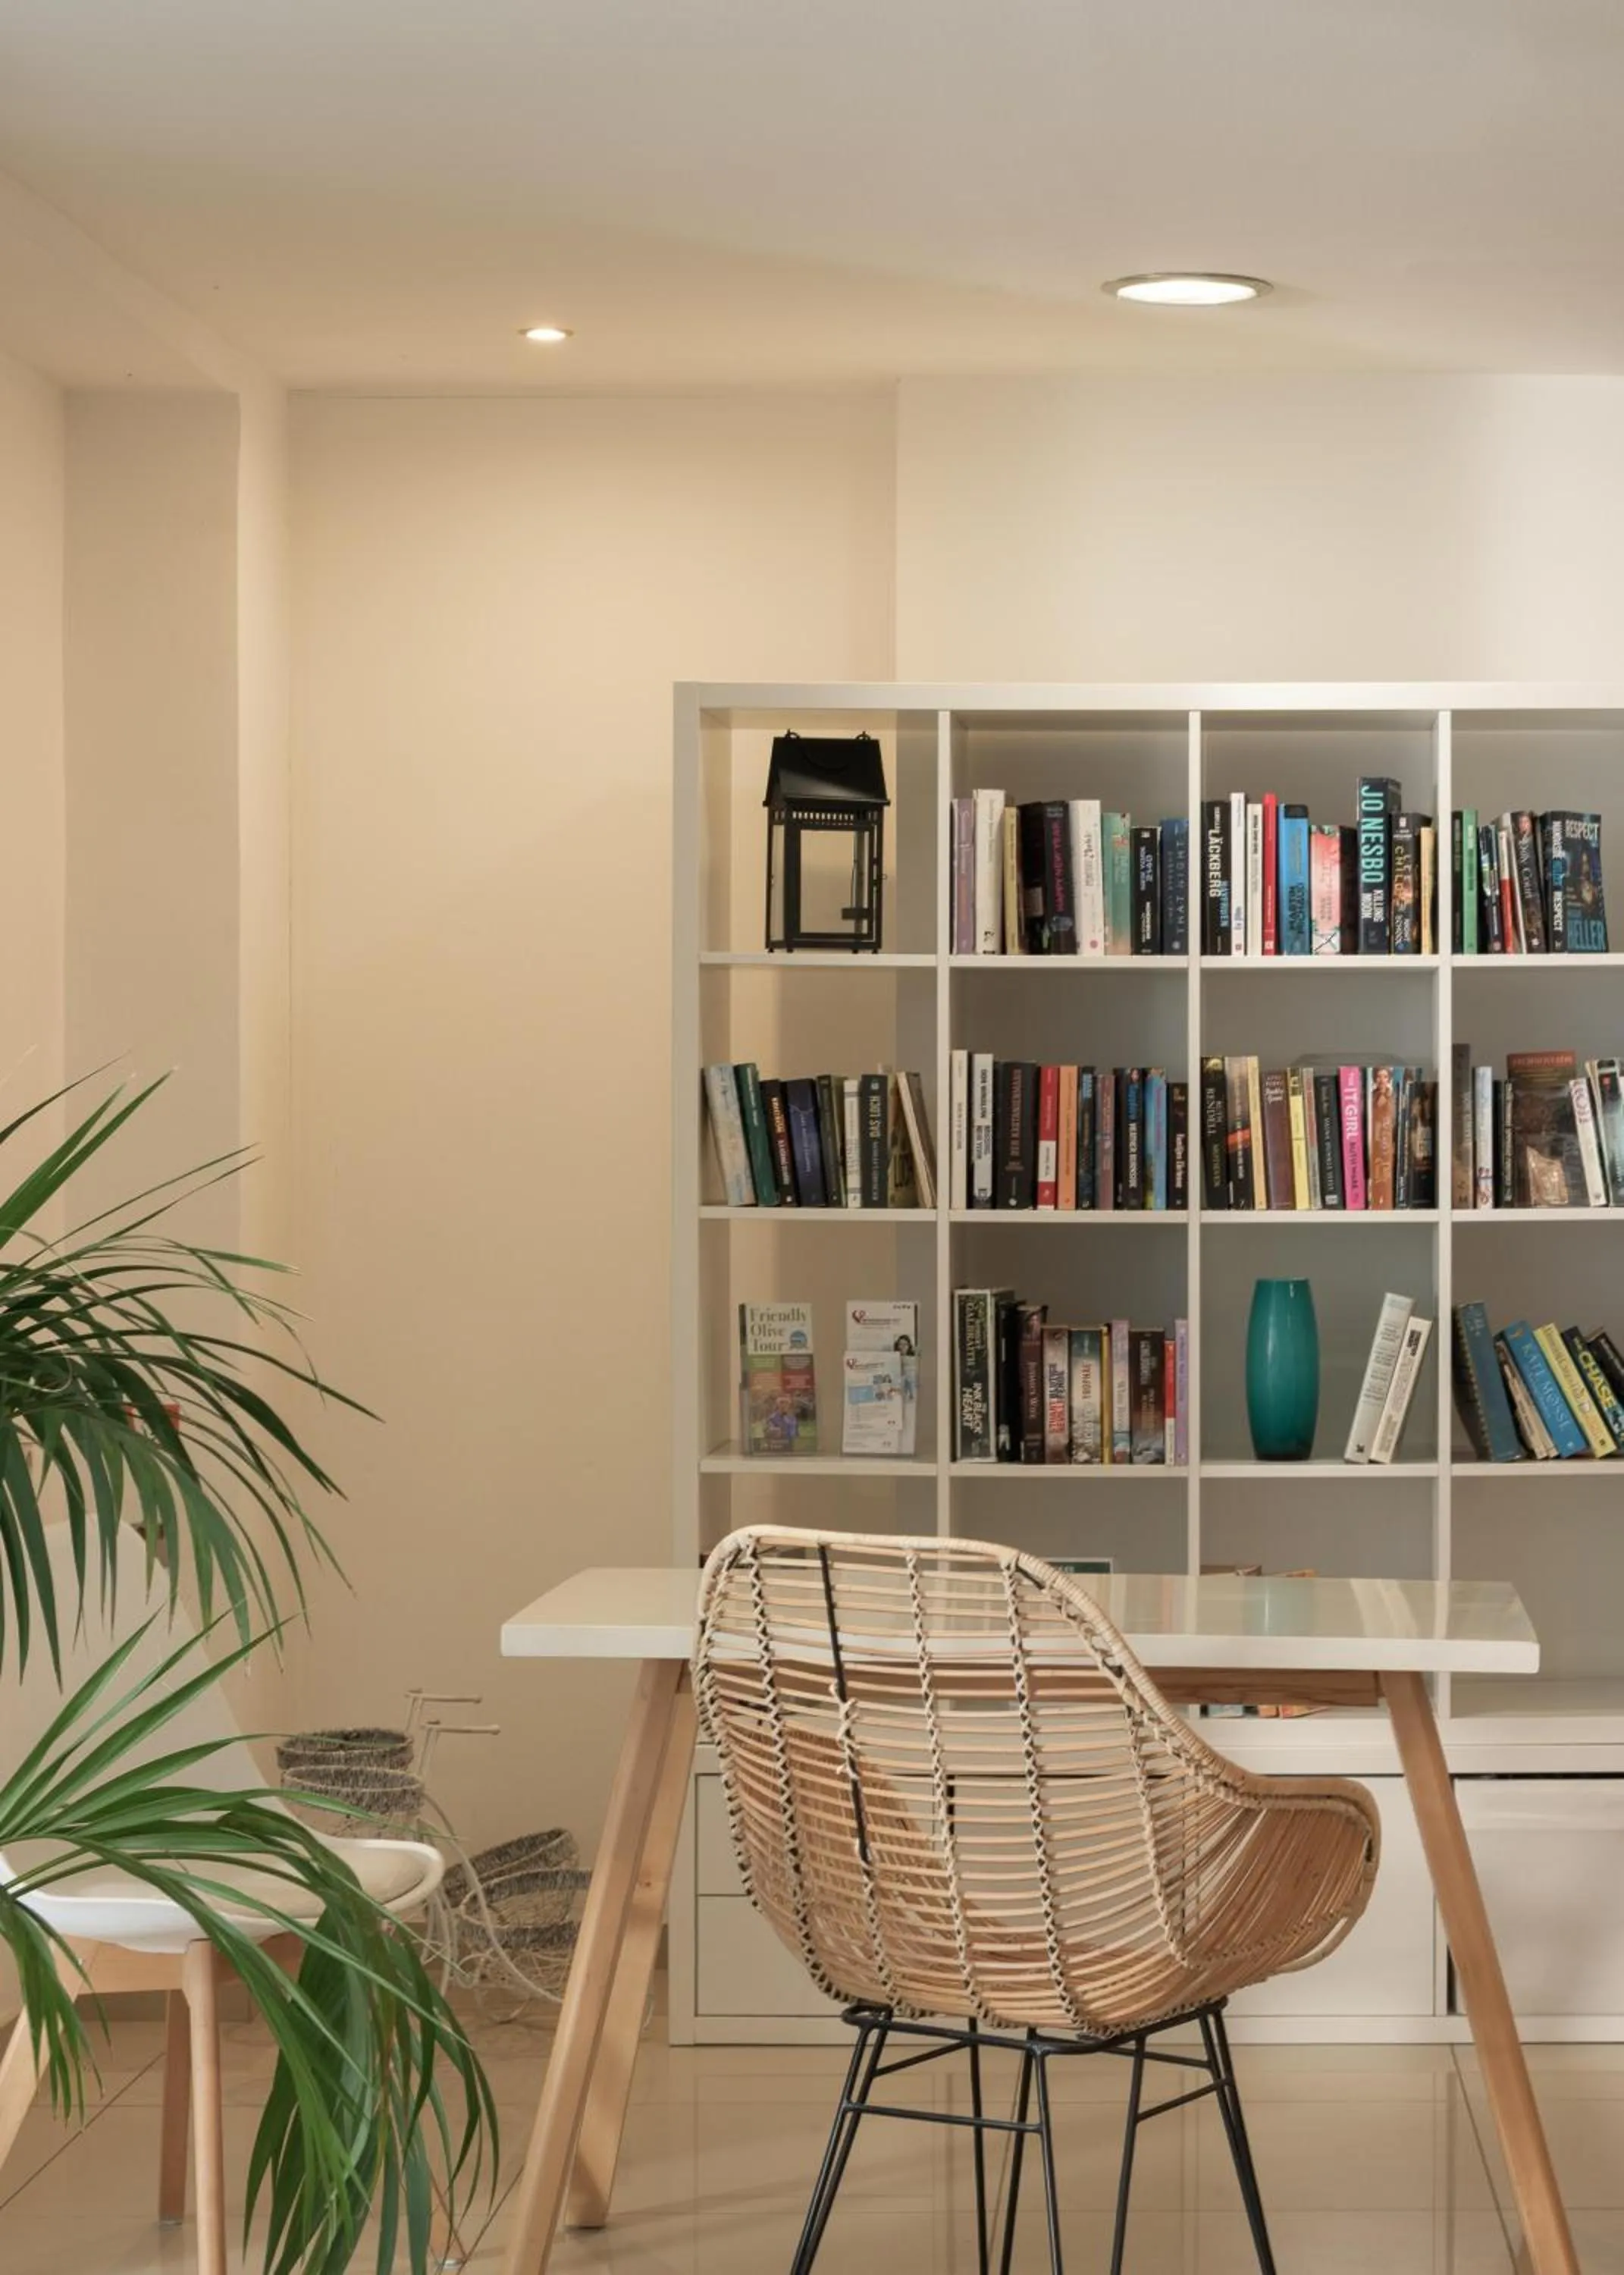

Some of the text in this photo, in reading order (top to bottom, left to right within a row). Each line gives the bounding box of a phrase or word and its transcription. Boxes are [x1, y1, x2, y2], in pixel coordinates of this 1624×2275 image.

[1361, 785, 1384, 883] JO NESBO
[1564, 820, 1600, 842] RESPECT
[1209, 829, 1223, 897] LÄCKBERG
[1176, 841, 1185, 934] THAT NIGHT
[1362, 893, 1372, 919] MOON
[1373, 889, 1384, 923] KILLING
[1205, 1087, 1216, 1134] RENDELL
[1343, 1087, 1358, 1103] IT
[1346, 1105, 1359, 1140] GIRL
[750, 1307, 807, 1323] Friendly
[751, 1323, 785, 1338] Olive
[752, 1338, 786, 1352] Tour
[1522, 1343, 1570, 1432] KATE MOSSE
[1579, 1351, 1616, 1408] CHASE
[962, 1387, 973, 1427] HEART
[971, 1382, 983, 1434] INK BLACK
